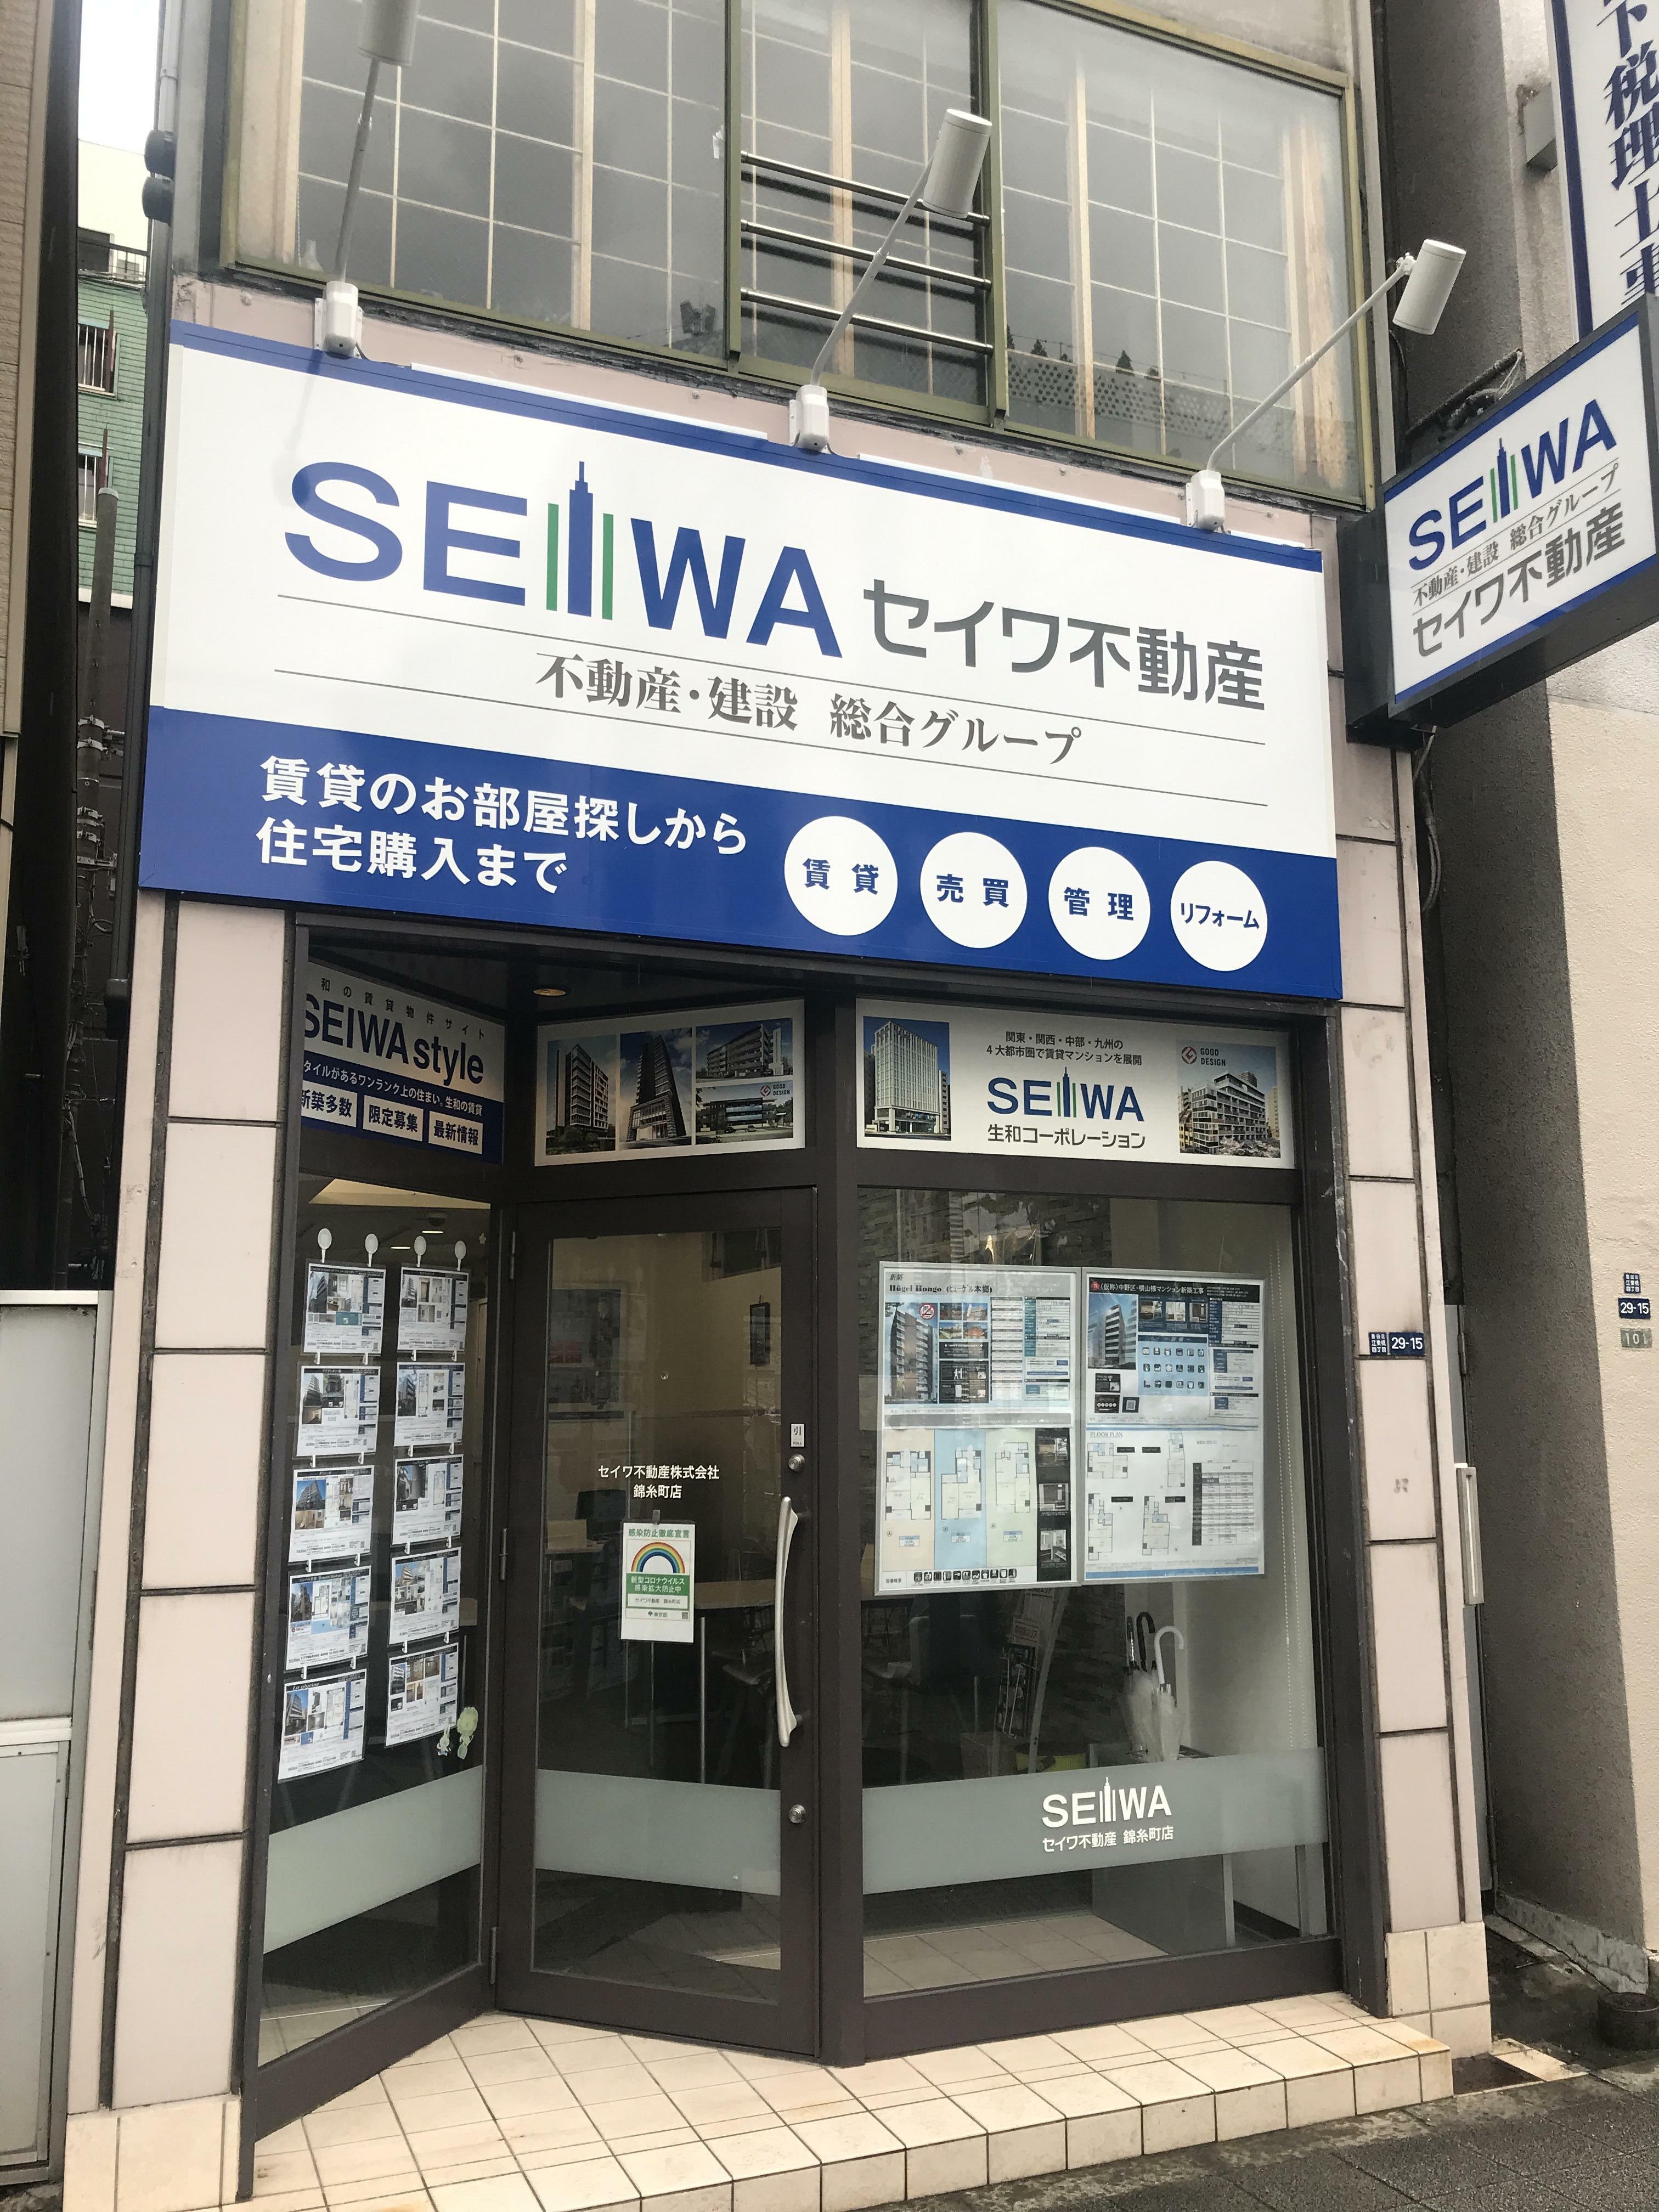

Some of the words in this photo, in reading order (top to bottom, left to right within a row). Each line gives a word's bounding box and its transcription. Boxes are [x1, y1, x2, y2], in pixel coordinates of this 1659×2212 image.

[1408, 399, 1617, 571] SEIWA
[1510, 463, 1619, 551] 総合グループ
[285, 461, 842, 658] SEIWA
[1413, 502, 1626, 657] セイワ不動産
[863, 579, 1266, 711] セイワ不動産
[830, 693, 1082, 765] 総合グループ
[261, 755, 747, 855] 賃貸のお部屋探しから
[256, 816, 567, 894] 住宅購入まで
[802, 858, 879, 895] 賃貸
[936, 874, 1009, 909] 売買
[1064, 887, 1134, 921] 管理
[1180, 902, 1260, 929] リフォーム
[1201, 1058, 1226, 1066] DESIGN
[988, 1066, 1144, 1122] SEIWA
[369, 1104, 418, 1132] 限定募集
[434, 1120, 478, 1146] 最新情報
[988, 1124, 1145, 1149] 生和コーポレーション
[1620, 1302, 1649, 1314] 29-15
[1391, 1337, 1423, 1350] 29-15
[793, 1426, 801, 1435] 引
[598, 1465, 719, 1480] セイワ不動産株式会社
[633, 1484, 682, 1499] 錦糸町店
[628, 1528, 690, 1538] 感染防止徹底宣言
[630, 1576, 685, 1585] 新型コロナウイルス
[634, 1584, 681, 1593] 感染拡大防止中
[1042, 1776, 1172, 1827] SEIWA
[1042, 1831, 1116, 1852] セイワ不動産
[1123, 1825, 1174, 1844] 錦糸町店
